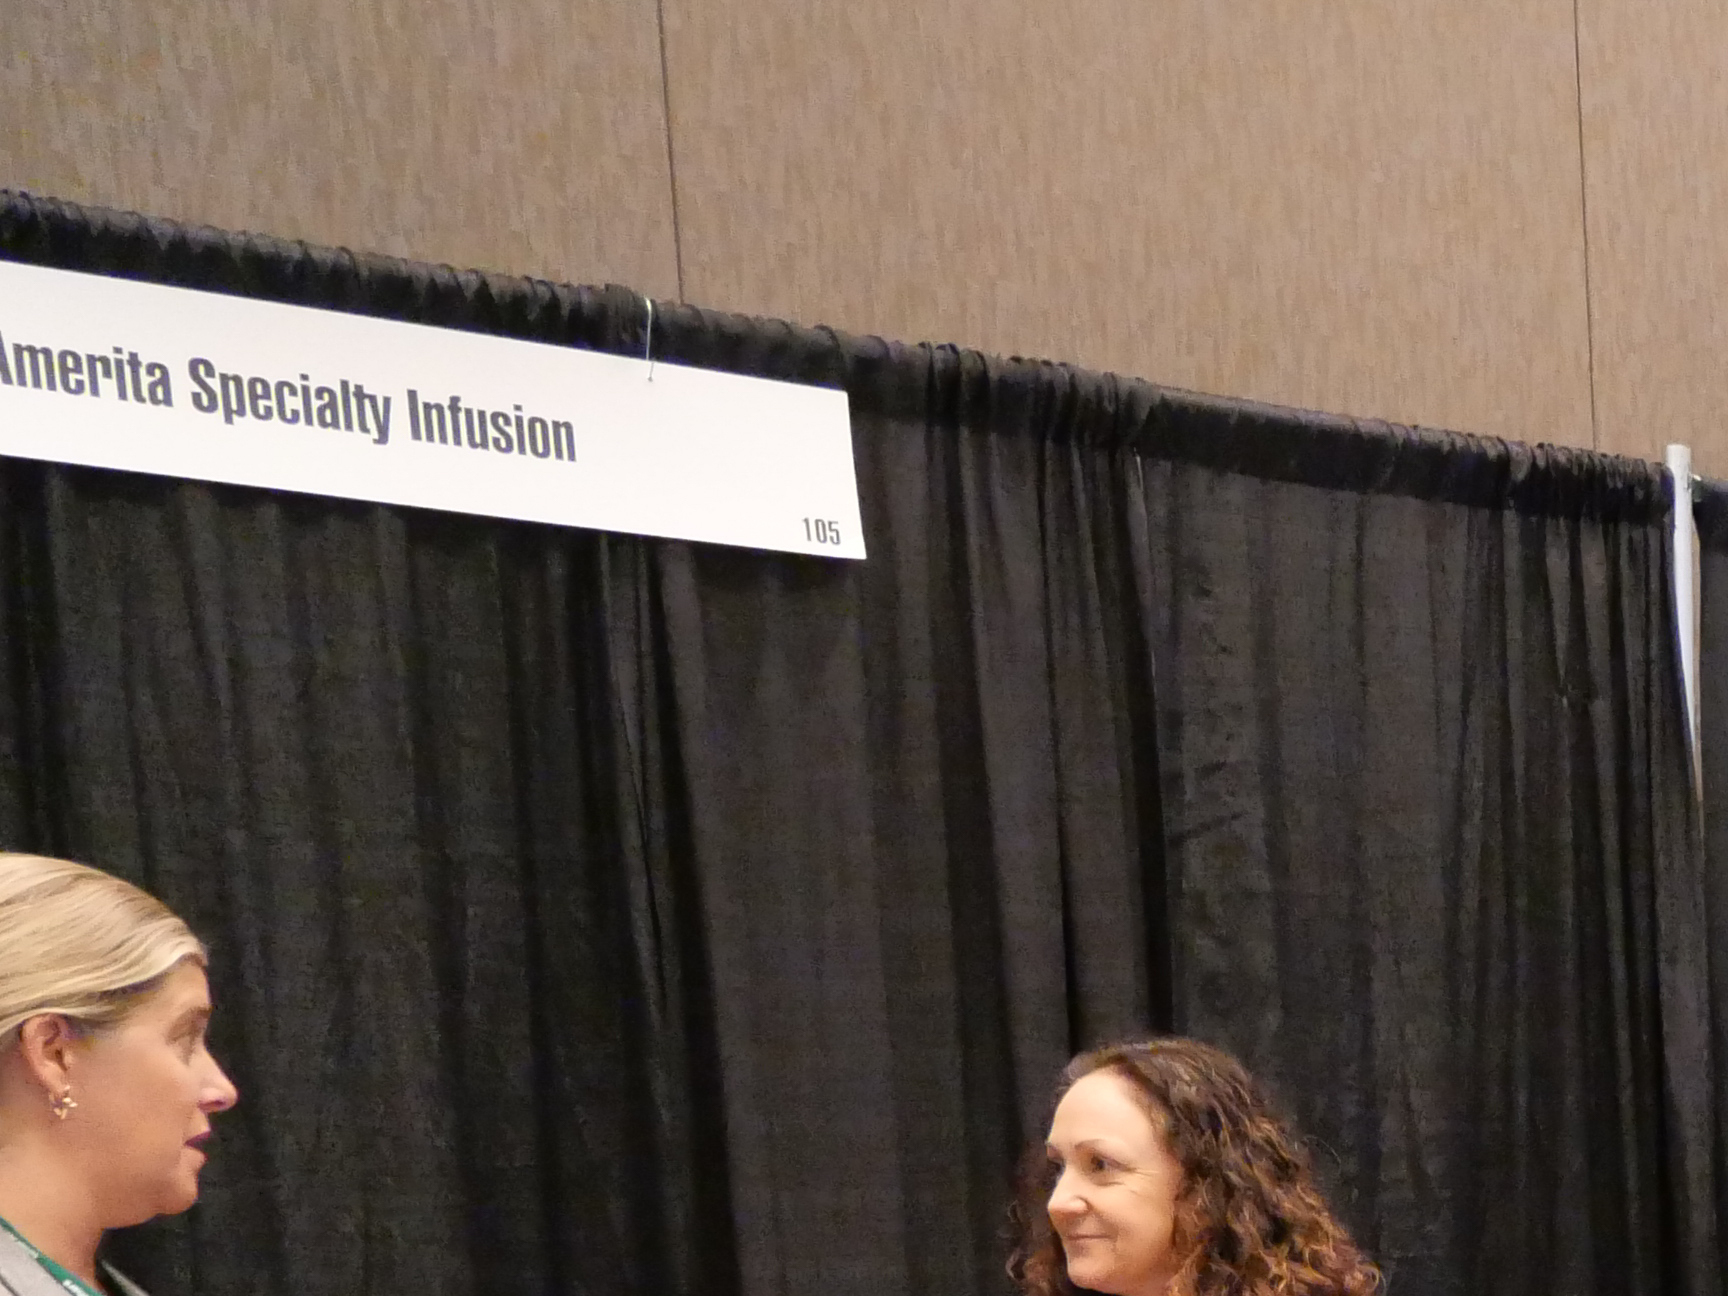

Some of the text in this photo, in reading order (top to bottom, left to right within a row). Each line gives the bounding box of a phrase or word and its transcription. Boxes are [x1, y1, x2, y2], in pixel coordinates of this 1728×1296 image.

[188, 356, 391, 446] Specialty
[408, 388, 577, 463] Infusion
[802, 516, 841, 547] 105
